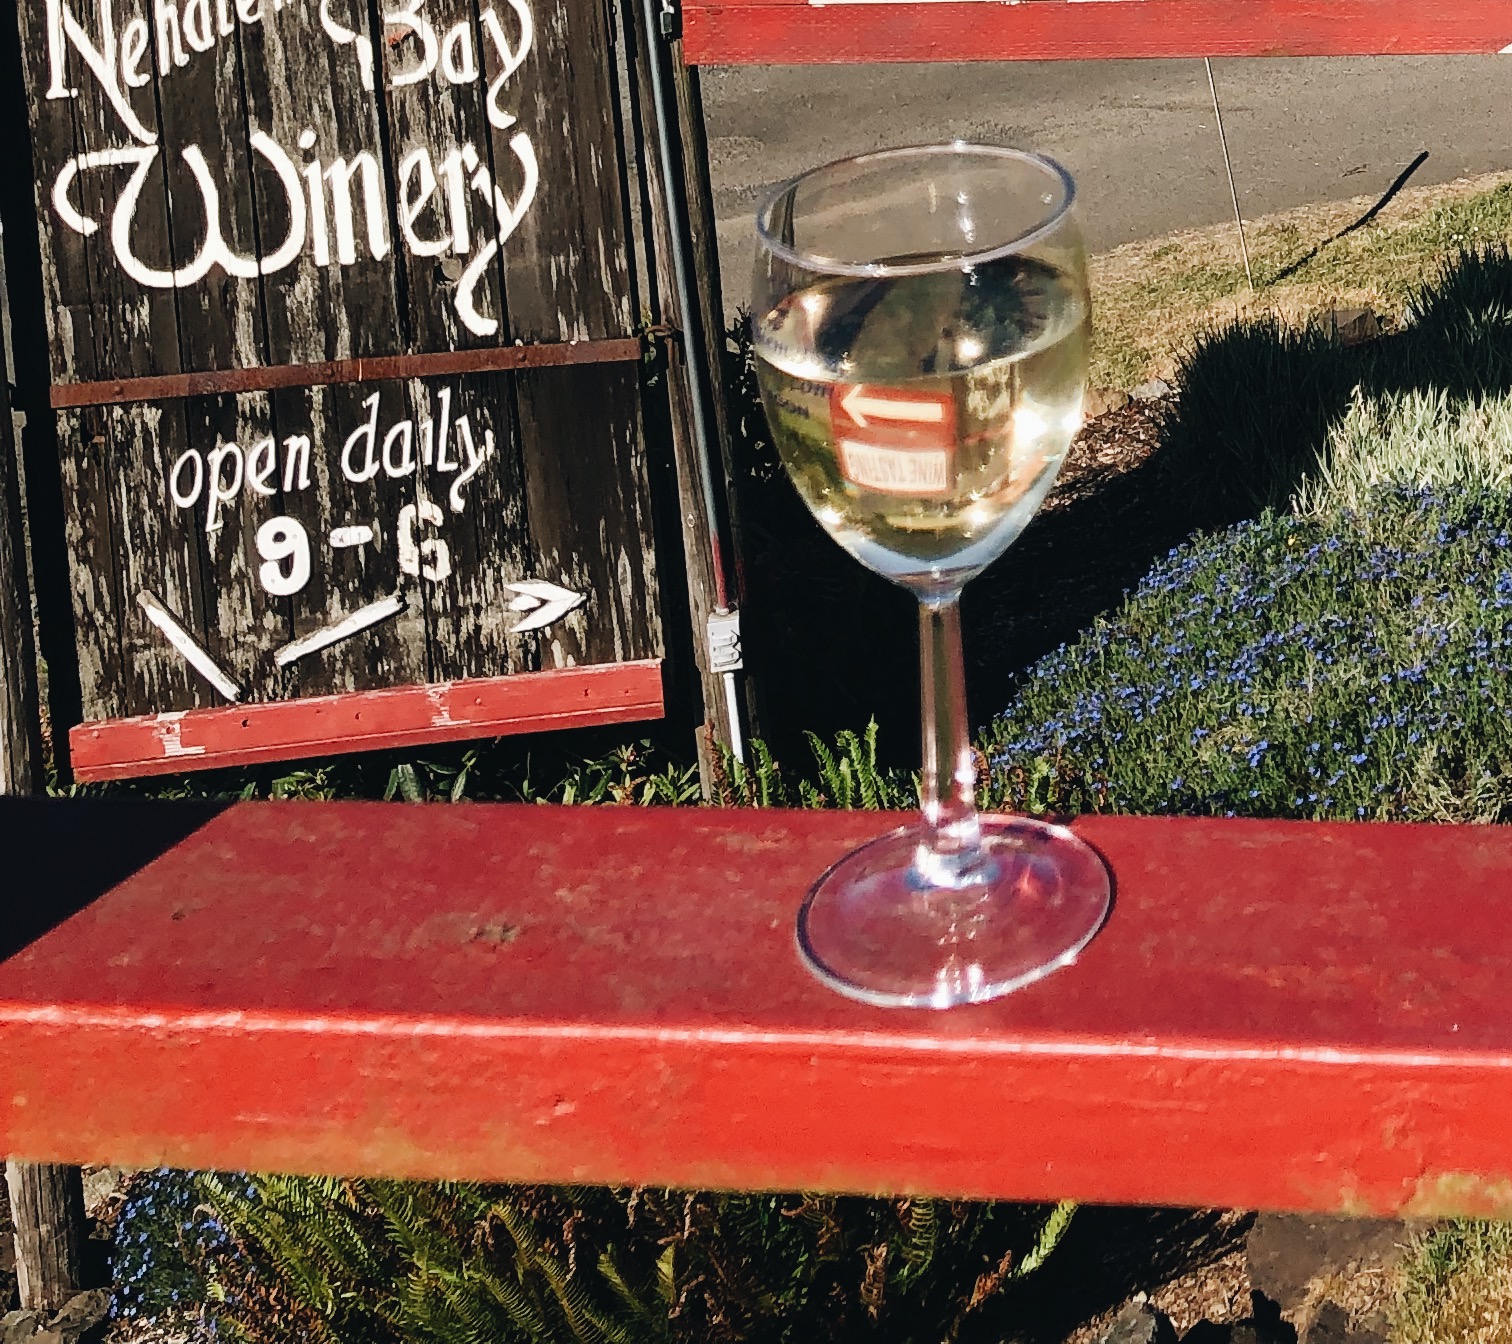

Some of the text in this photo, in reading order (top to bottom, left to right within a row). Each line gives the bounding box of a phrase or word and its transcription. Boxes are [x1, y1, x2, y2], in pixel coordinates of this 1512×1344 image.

[52, 129, 539, 337] Winery
[169, 389, 496, 533] open daily
